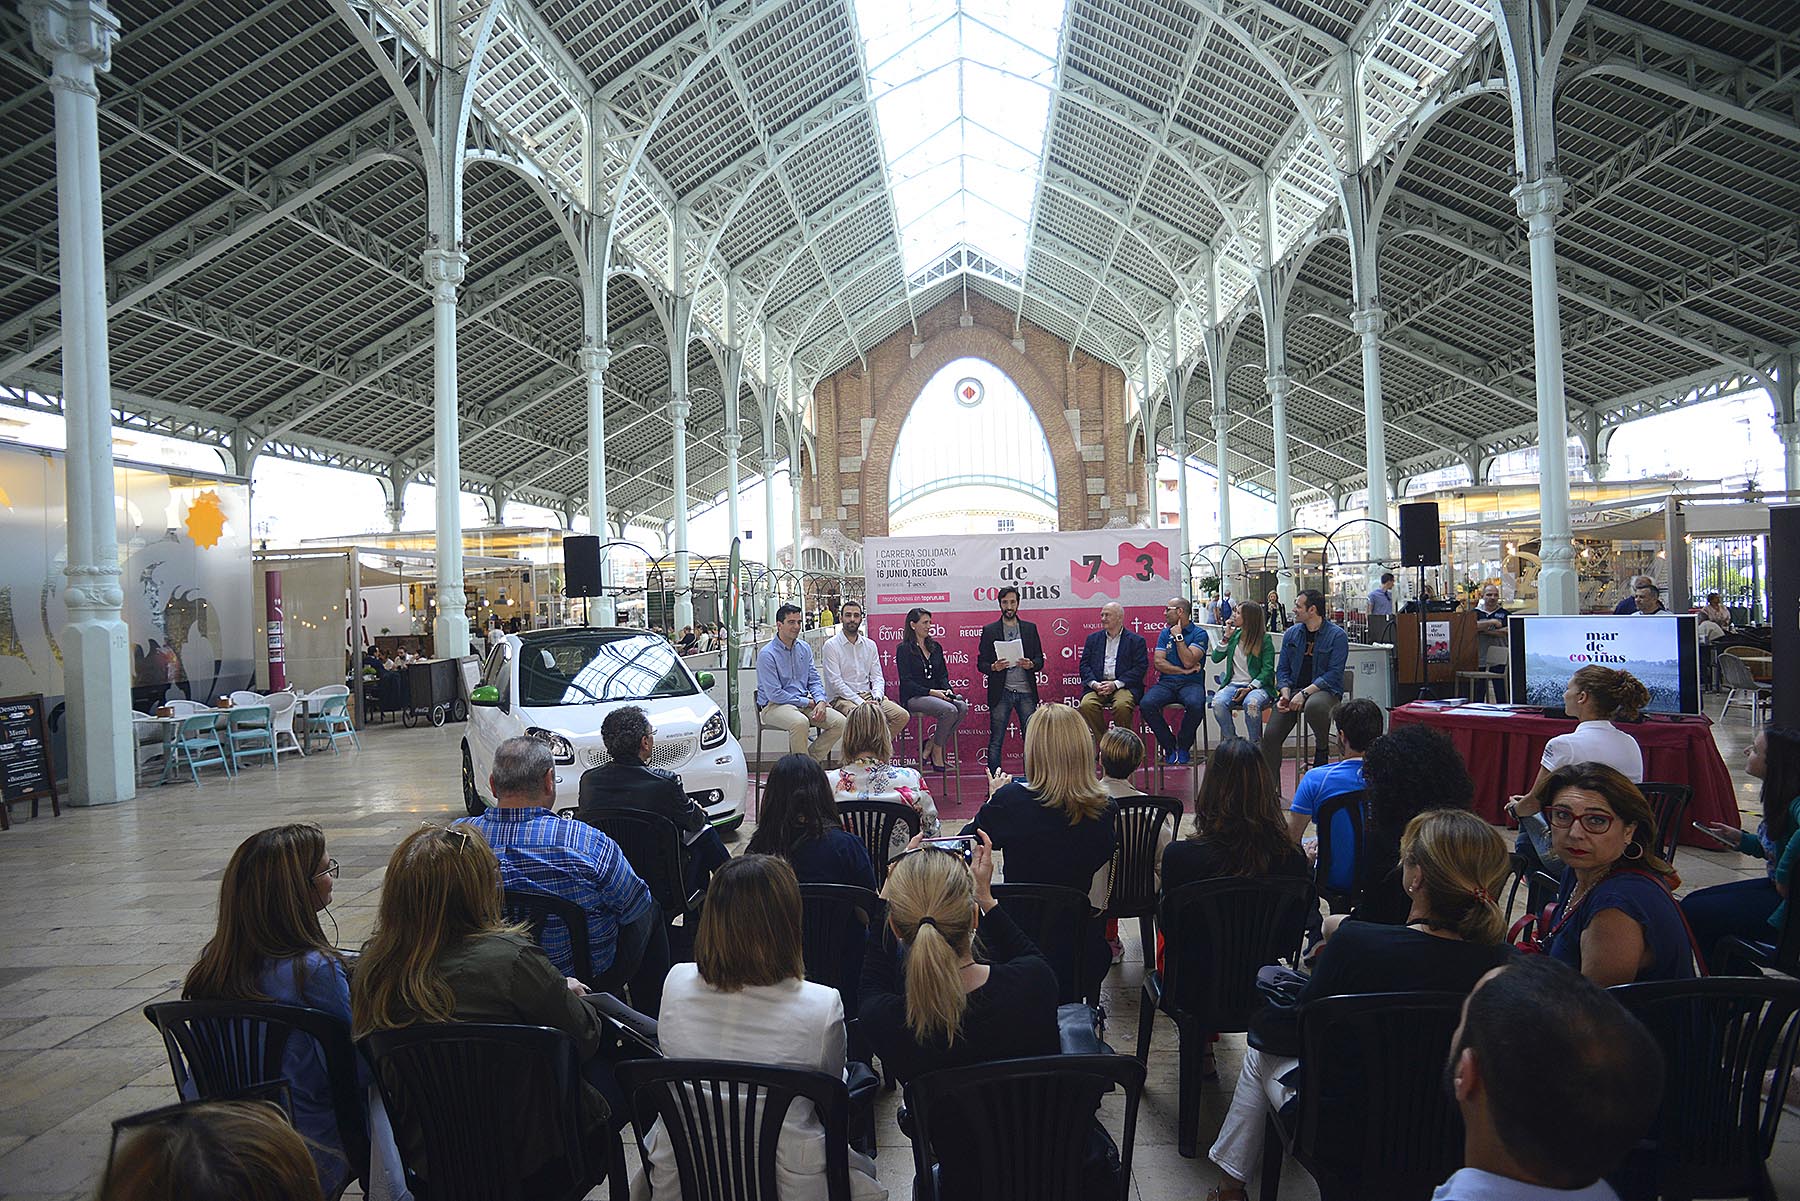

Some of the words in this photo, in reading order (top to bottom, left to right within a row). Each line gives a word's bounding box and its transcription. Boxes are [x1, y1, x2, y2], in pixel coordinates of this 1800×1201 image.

[880, 549, 916, 559] CARRERA
[917, 548, 957, 558] SOLIDARIA
[1000, 546, 1050, 561] mar
[876, 560, 901, 569] ENTRE
[876, 569, 885, 578] 16
[886, 568, 911, 579] JUNIO,
[911, 568, 948, 578] REQUENA
[1000, 562, 1028, 581] de
[879, 628, 904, 641] COVIÑ
[960, 629, 983, 637] REQUE
[1586, 632, 1619, 641] mar
[1586, 641, 1605, 652] de
[944, 650, 969, 664] VIÑAS
[1569, 652, 1626, 664] coviñas
[948, 678, 970, 688] ecc
[1062, 677, 1082, 685] REQU
[974, 702, 990, 713] ae
